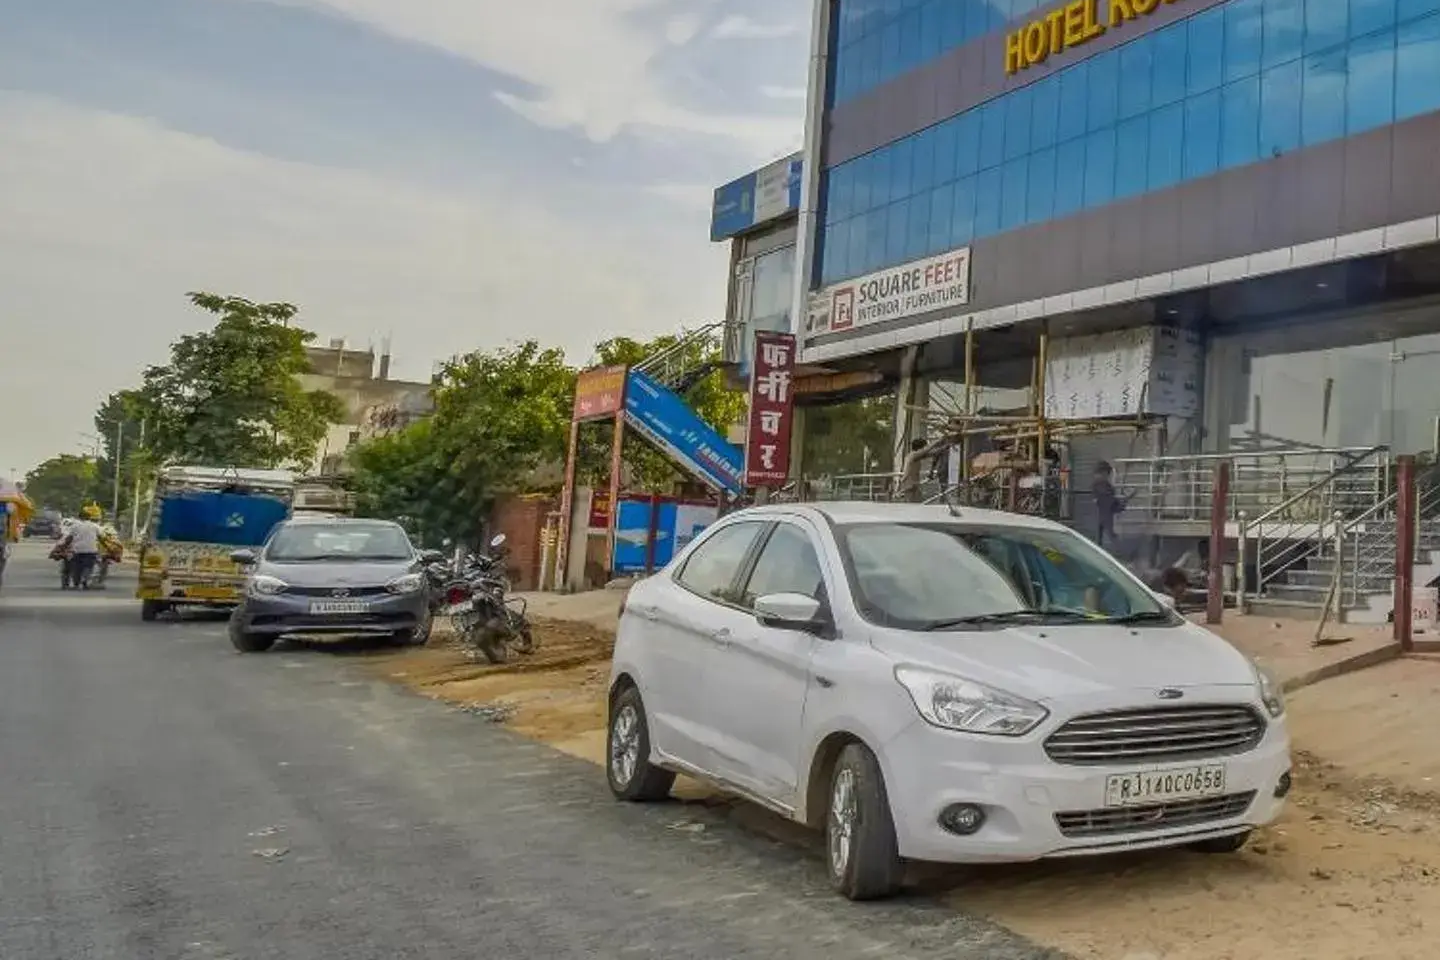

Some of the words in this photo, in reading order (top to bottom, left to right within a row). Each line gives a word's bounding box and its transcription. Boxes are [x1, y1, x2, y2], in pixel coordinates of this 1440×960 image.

[858, 268, 921, 304] SQUARE
[923, 256, 965, 288] FEET
[857, 299, 900, 322] INTERIOR
[905, 284, 965, 311] FURNITURE
